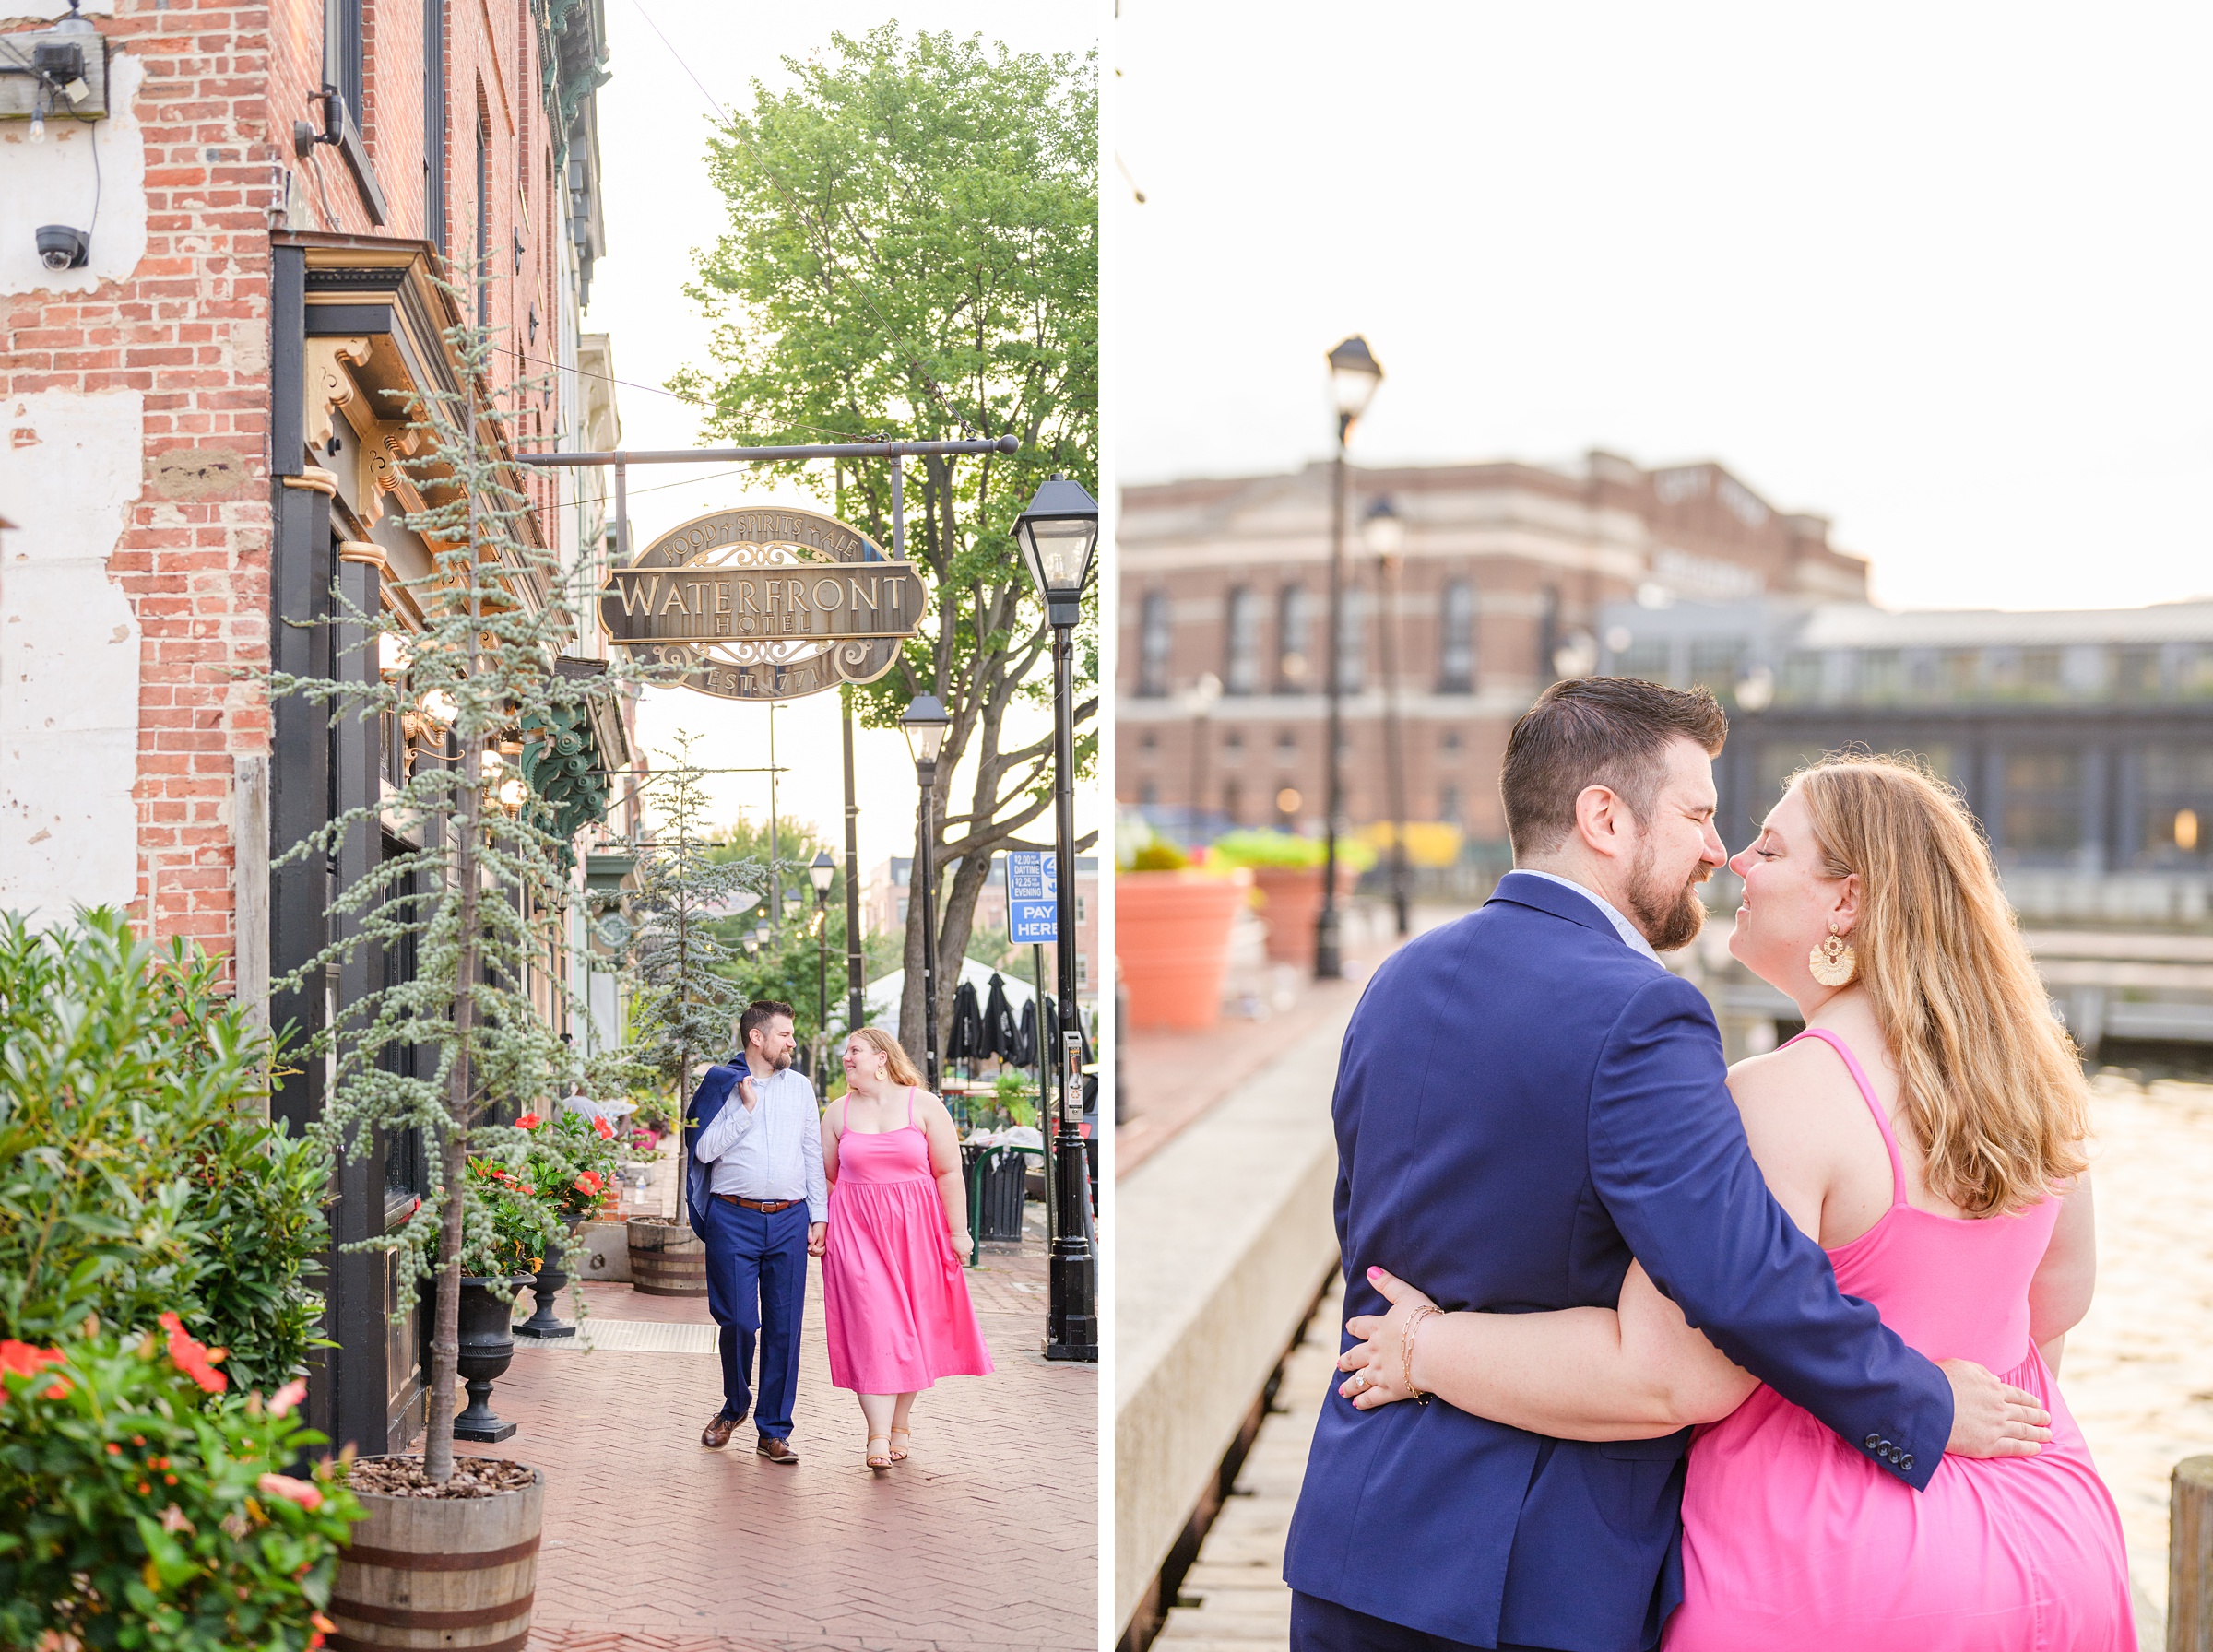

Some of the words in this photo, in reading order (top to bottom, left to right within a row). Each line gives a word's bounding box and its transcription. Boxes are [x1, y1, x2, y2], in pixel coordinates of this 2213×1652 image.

[661, 523, 717, 562] FOOD
[737, 513, 803, 536] SPIRITS
[820, 528, 859, 558] ALE
[616, 574, 908, 617] WATERFRONT
[716, 615, 811, 634] HOTEL
[706, 669, 758, 691] EST.
[767, 667, 820, 690] 1771
[1014, 855, 1031, 865] $2.00
[1014, 865, 1040, 875] DAYTIME
[1015, 877, 1032, 887] $2.25
[1014, 888, 1042, 897] EVENING
[1024, 906, 1054, 919] PAY
